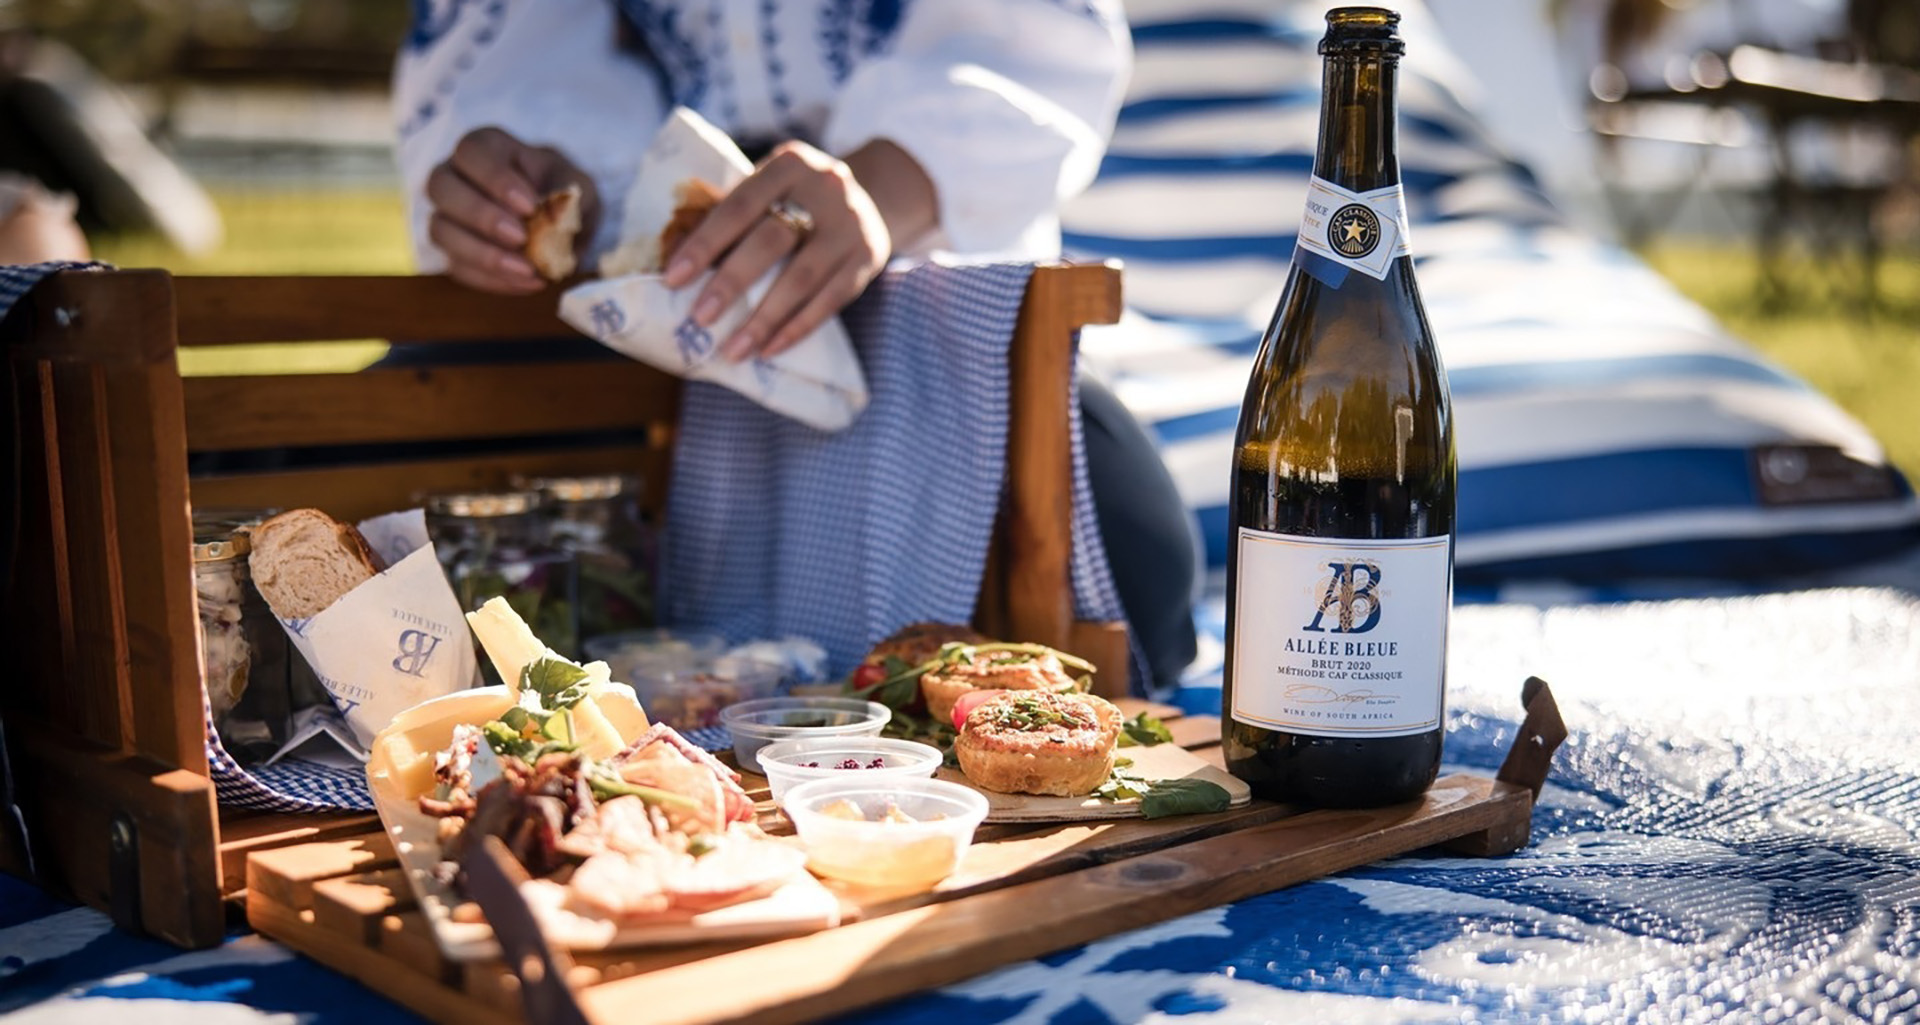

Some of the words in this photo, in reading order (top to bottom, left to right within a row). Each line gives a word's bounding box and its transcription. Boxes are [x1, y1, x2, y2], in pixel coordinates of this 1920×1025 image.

[1343, 208, 1377, 236] CLASSIQUE
[1284, 638, 1339, 656] ALLÉE
[1345, 642, 1398, 656] BLEUE
[1277, 665, 1326, 679] MÉTHODE
[1328, 670, 1348, 680] CAP
[1350, 671, 1403, 681] CLASSIQUE
[1311, 659, 1344, 671] BRUT
[1347, 661, 1372, 671] 2020
[1283, 707, 1305, 716] WINE
